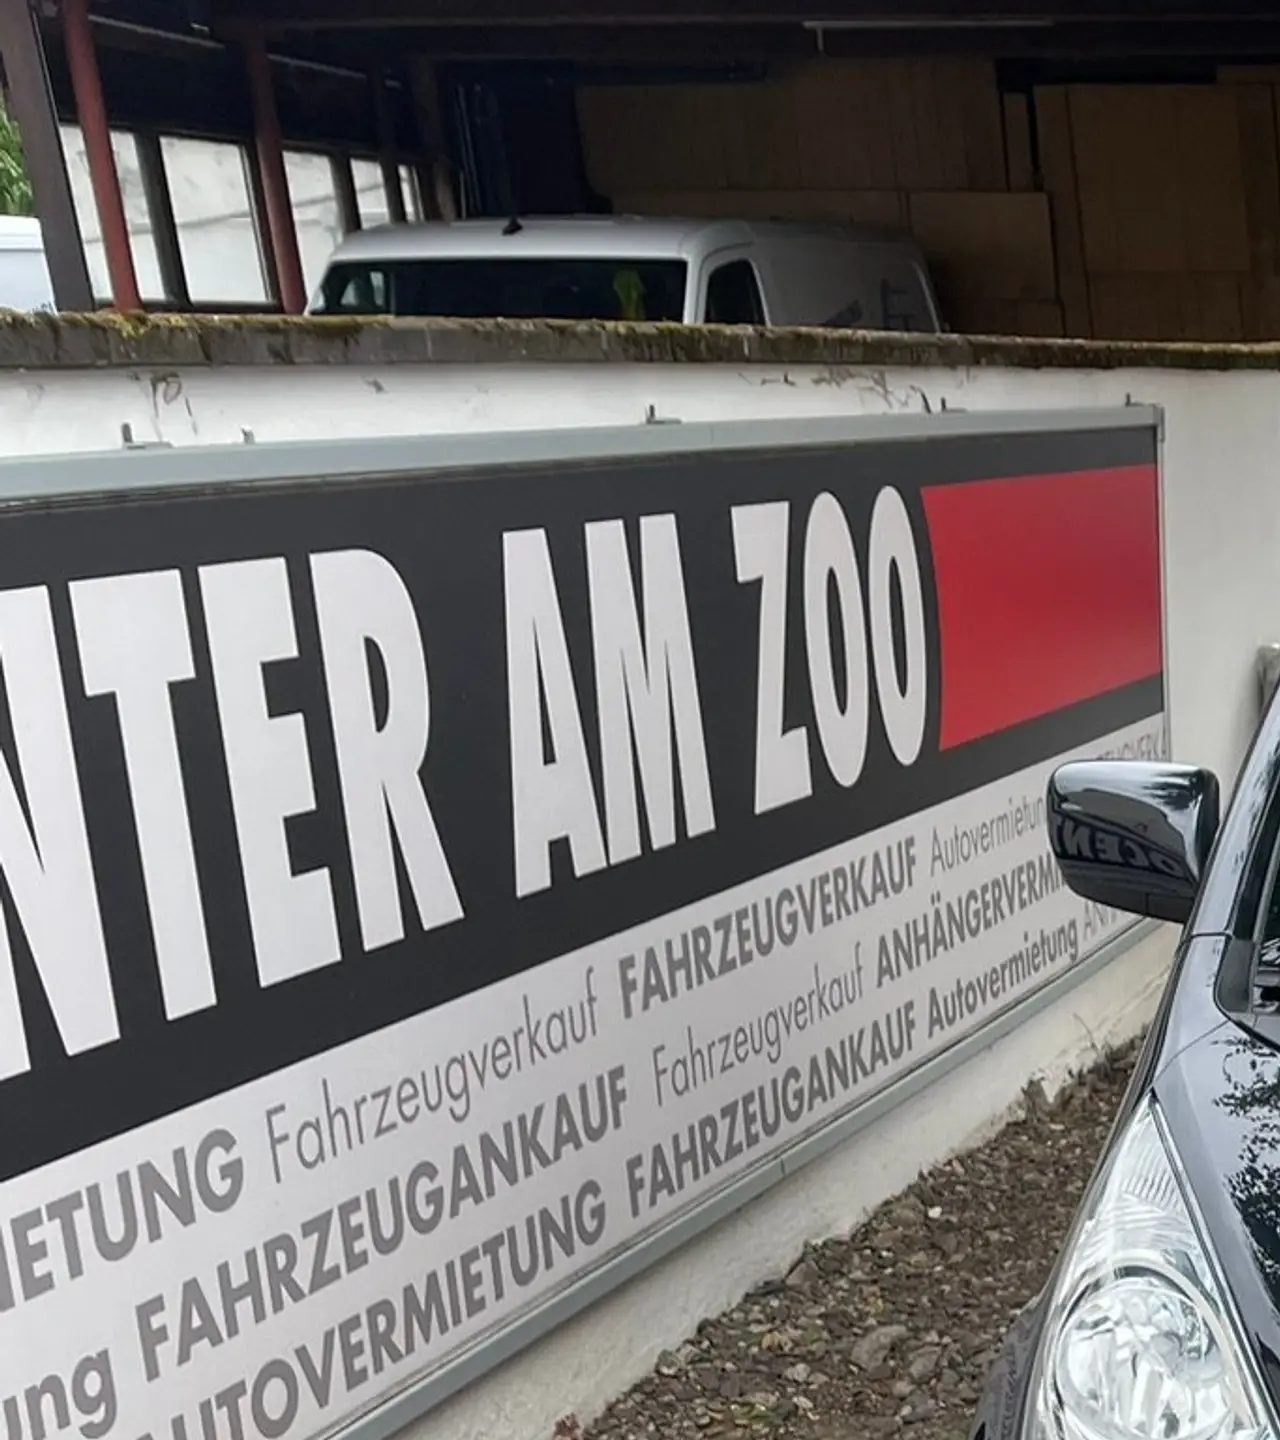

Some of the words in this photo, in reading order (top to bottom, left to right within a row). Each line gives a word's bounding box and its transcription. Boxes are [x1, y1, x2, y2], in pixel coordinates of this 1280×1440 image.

[502, 513, 716, 899] AM
[730, 485, 927, 815] ZOO
[135, 1065, 627, 1382] FAHRZEUGANKAUF
[651, 941, 865, 1107] Fahrzeugverkauf
[876, 851, 1065, 988] ANHÄNGERVERMI
[265, 967, 600, 1184] Fahrzeugverkauf
[618, 835, 917, 1020] FAHRZEUGVERKAUF
[626, 1001, 916, 1219] FAHRZEUGANKAUF
[928, 917, 1079, 1038] Autovermietung
